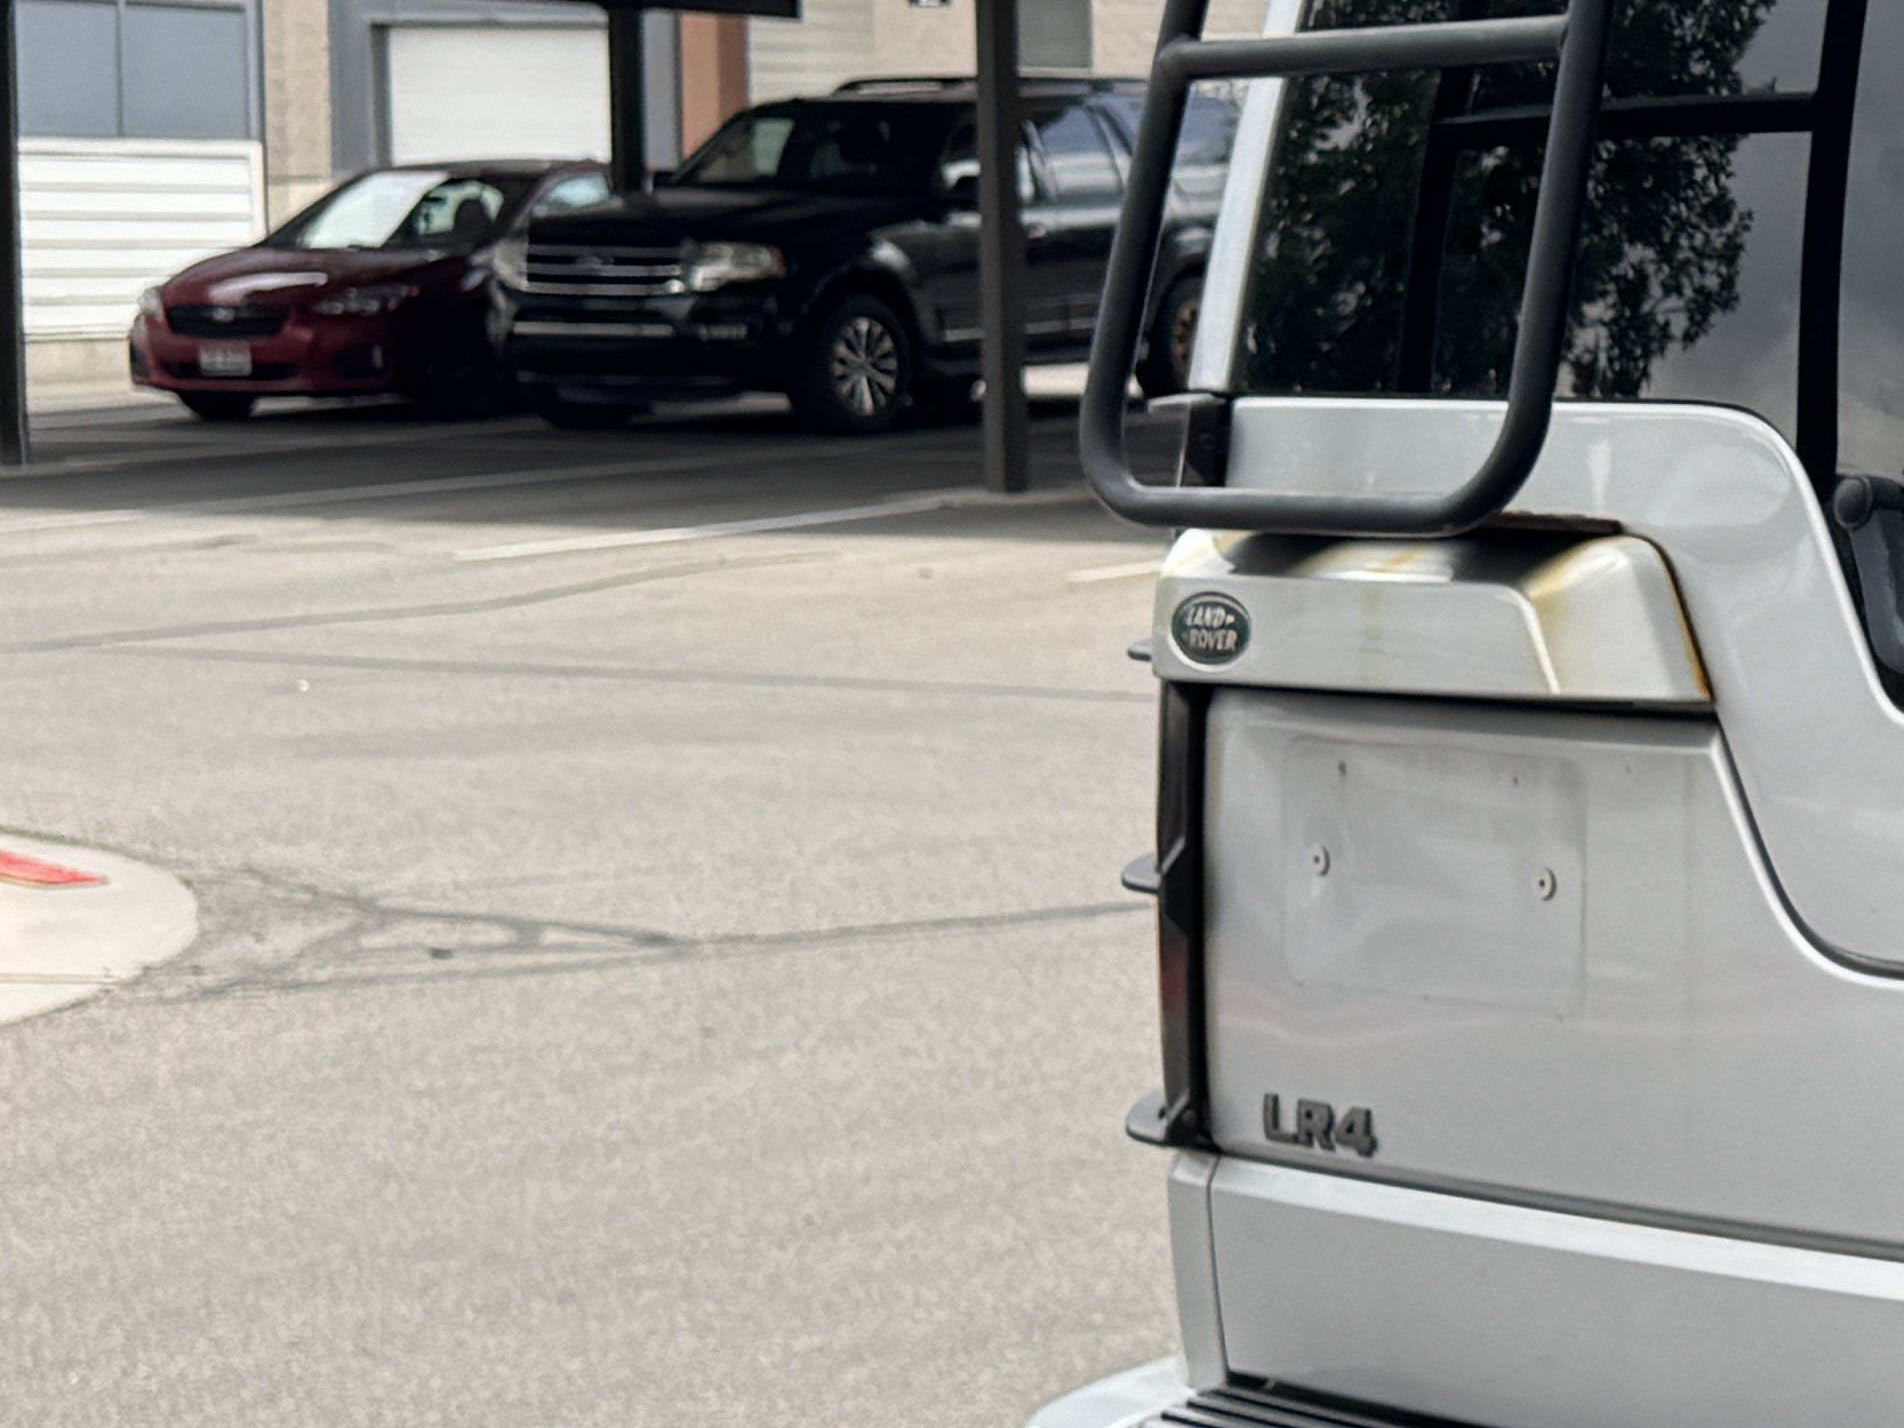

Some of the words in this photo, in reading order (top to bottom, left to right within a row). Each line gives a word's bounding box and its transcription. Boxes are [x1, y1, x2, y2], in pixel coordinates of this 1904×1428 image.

[1185, 604, 1226, 629] LAND
[1188, 628, 1238, 651] ROVER
[1262, 1092, 1378, 1159] LR4
